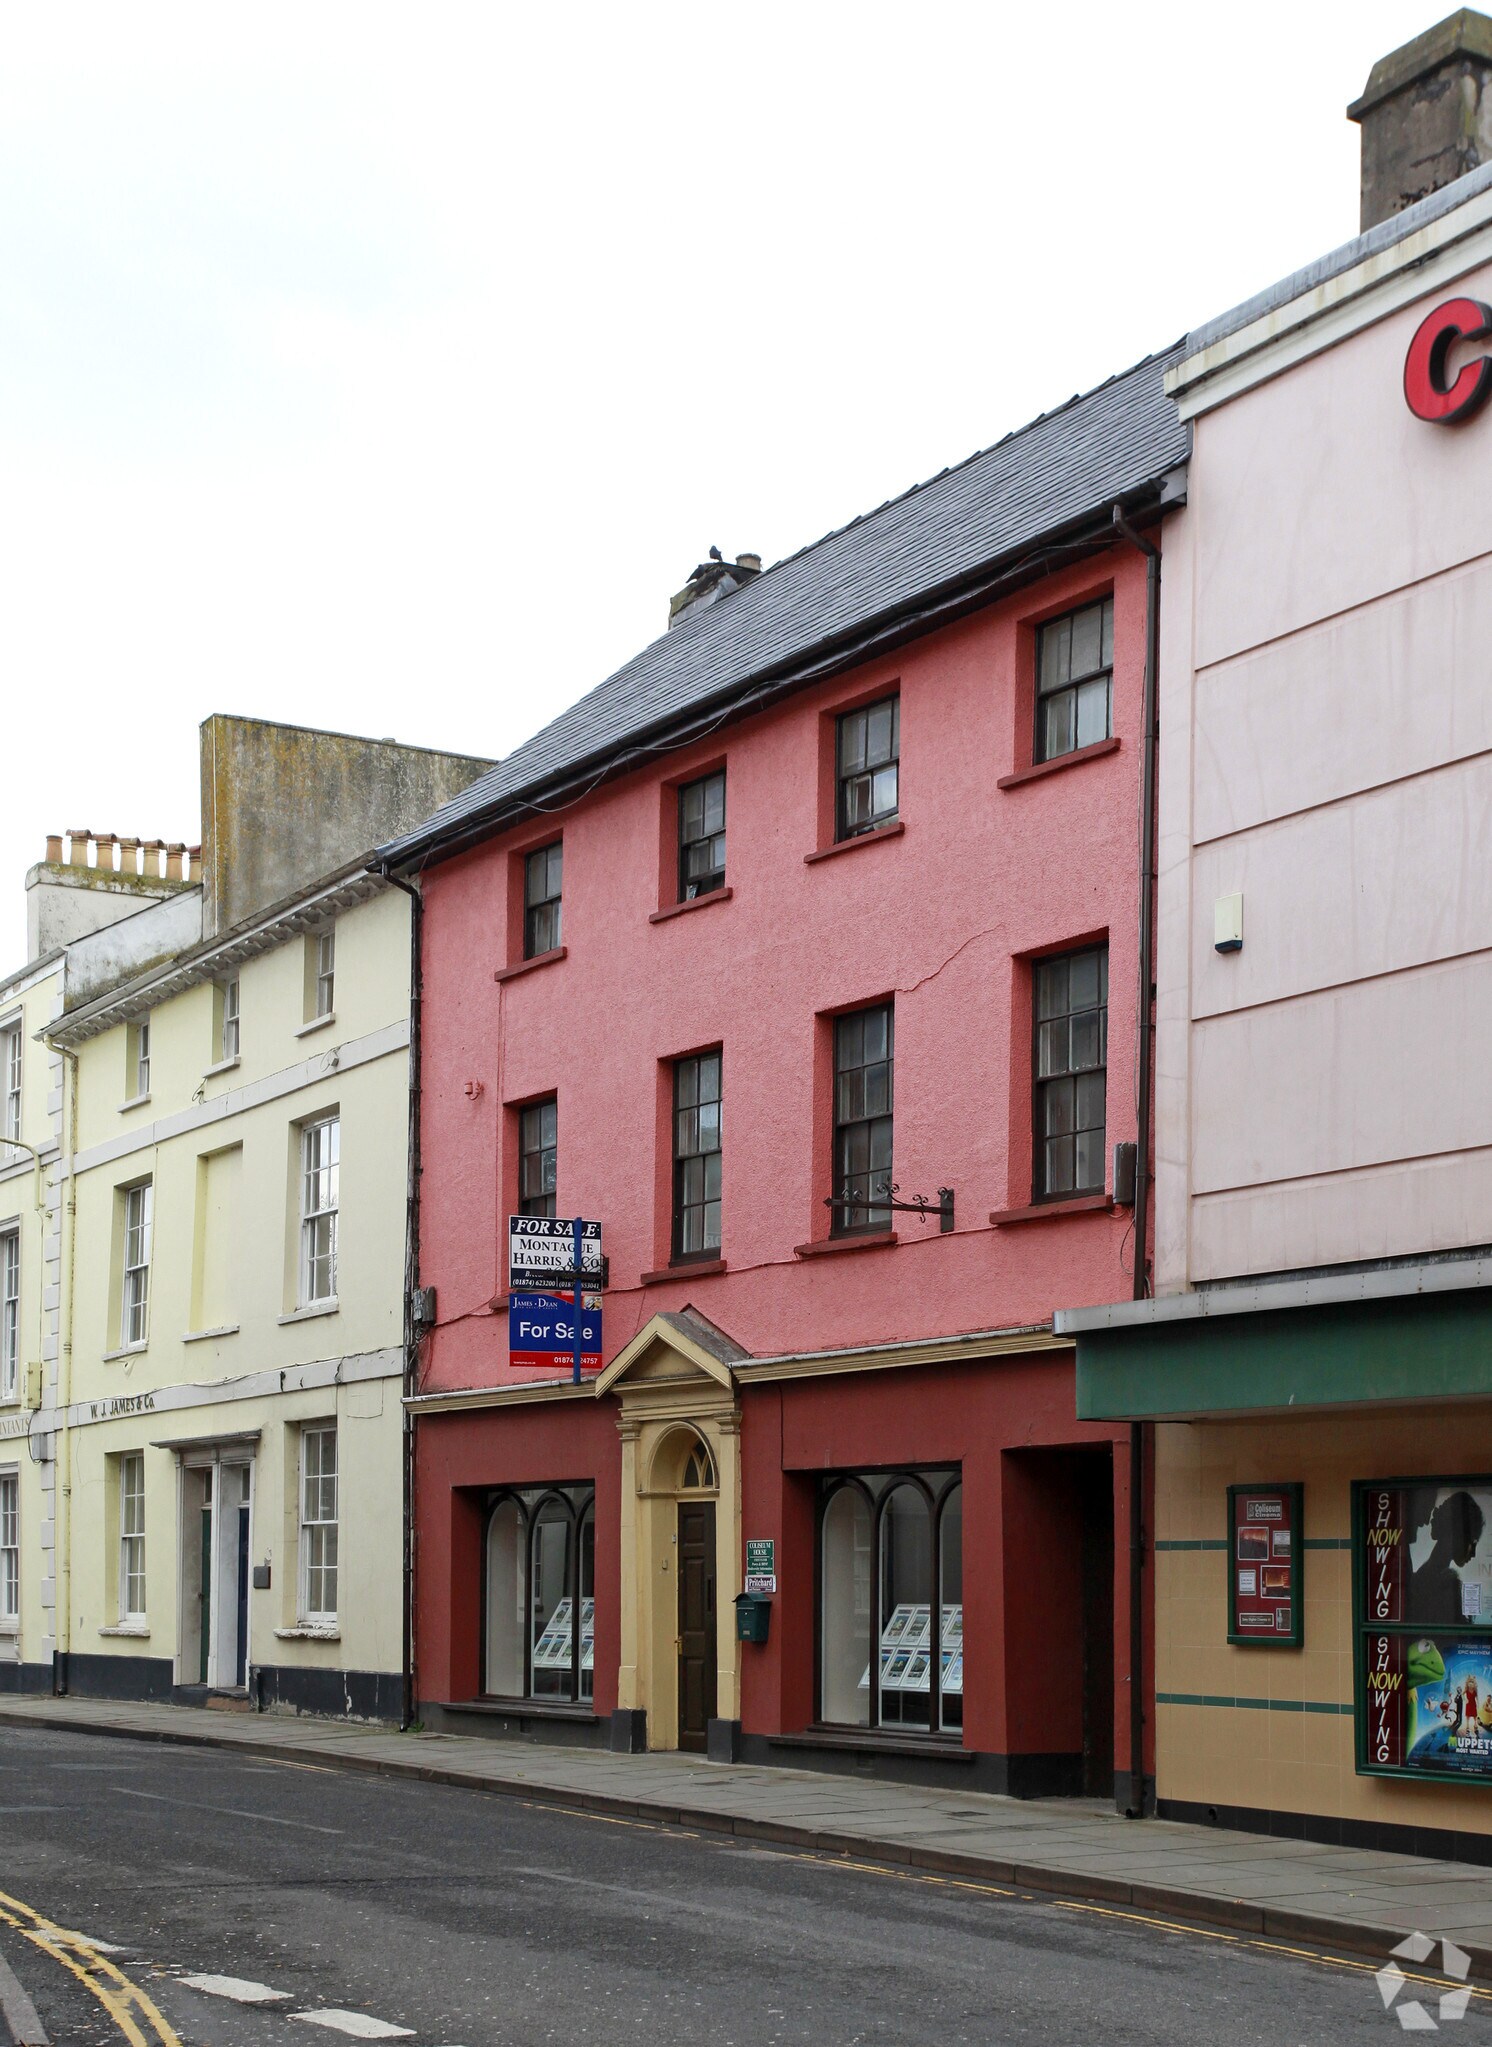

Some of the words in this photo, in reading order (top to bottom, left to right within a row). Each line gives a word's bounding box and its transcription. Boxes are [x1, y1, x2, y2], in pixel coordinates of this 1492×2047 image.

[515, 1219, 550, 1234] FOR
[554, 1221, 597, 1237] SAE
[512, 1278, 535, 1287] (01874)
[535, 1279, 556, 1287] 623200
[519, 1321, 551, 1338] For
[555, 1322, 593, 1340] Sae
[553, 1356, 574, 1364] 01874
[110, 1397, 135, 1416] JAMES
[136, 1396, 142, 1411] &
[1254, 1503, 1281, 1512] Coliseum
[1366, 1528, 1402, 1546] NOW
[749, 1578, 773, 1587] Pritchard
[1367, 1671, 1403, 1691] NOW
